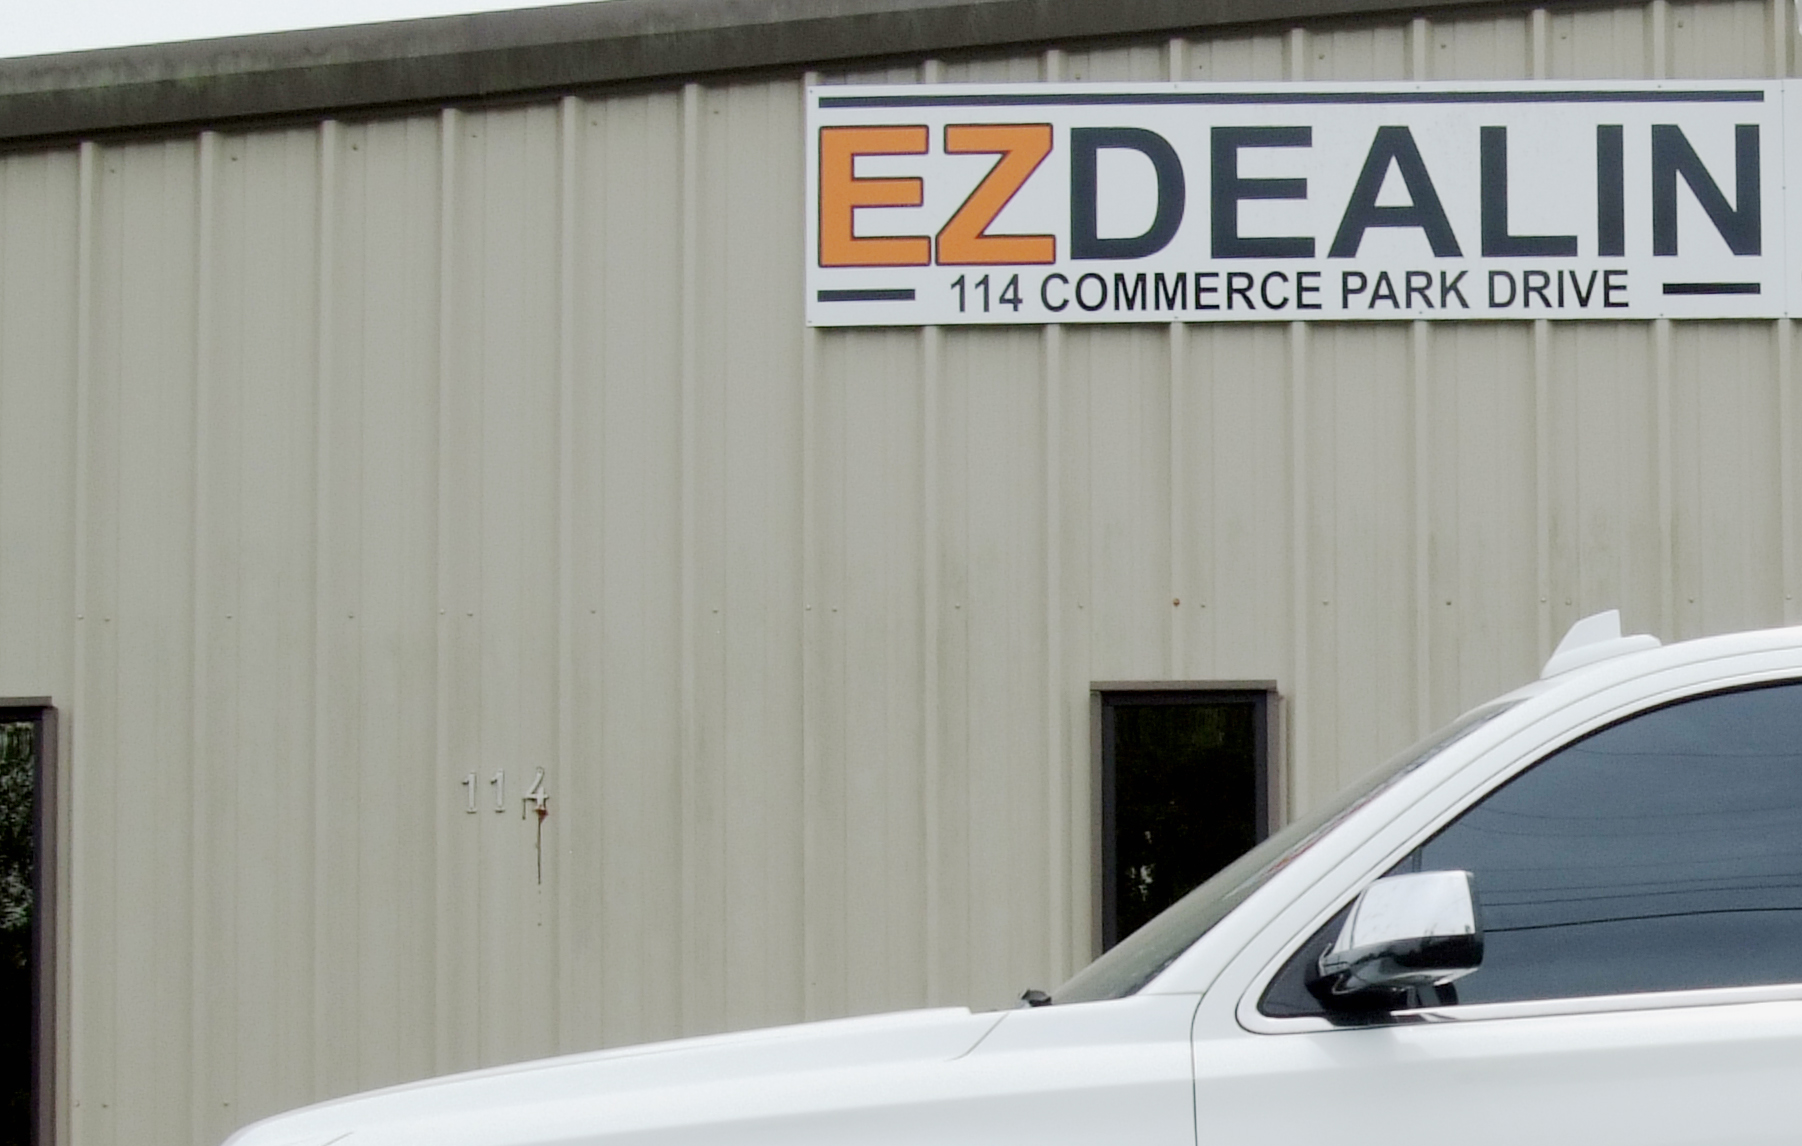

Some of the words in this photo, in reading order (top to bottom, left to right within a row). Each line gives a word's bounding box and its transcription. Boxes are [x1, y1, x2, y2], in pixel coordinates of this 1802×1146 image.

[950, 273, 1023, 312] 114
[1040, 271, 1323, 312] COMMERCE
[1341, 270, 1470, 310] PARK
[1488, 269, 1630, 308] DRIVE
[462, 766, 549, 815] 114
